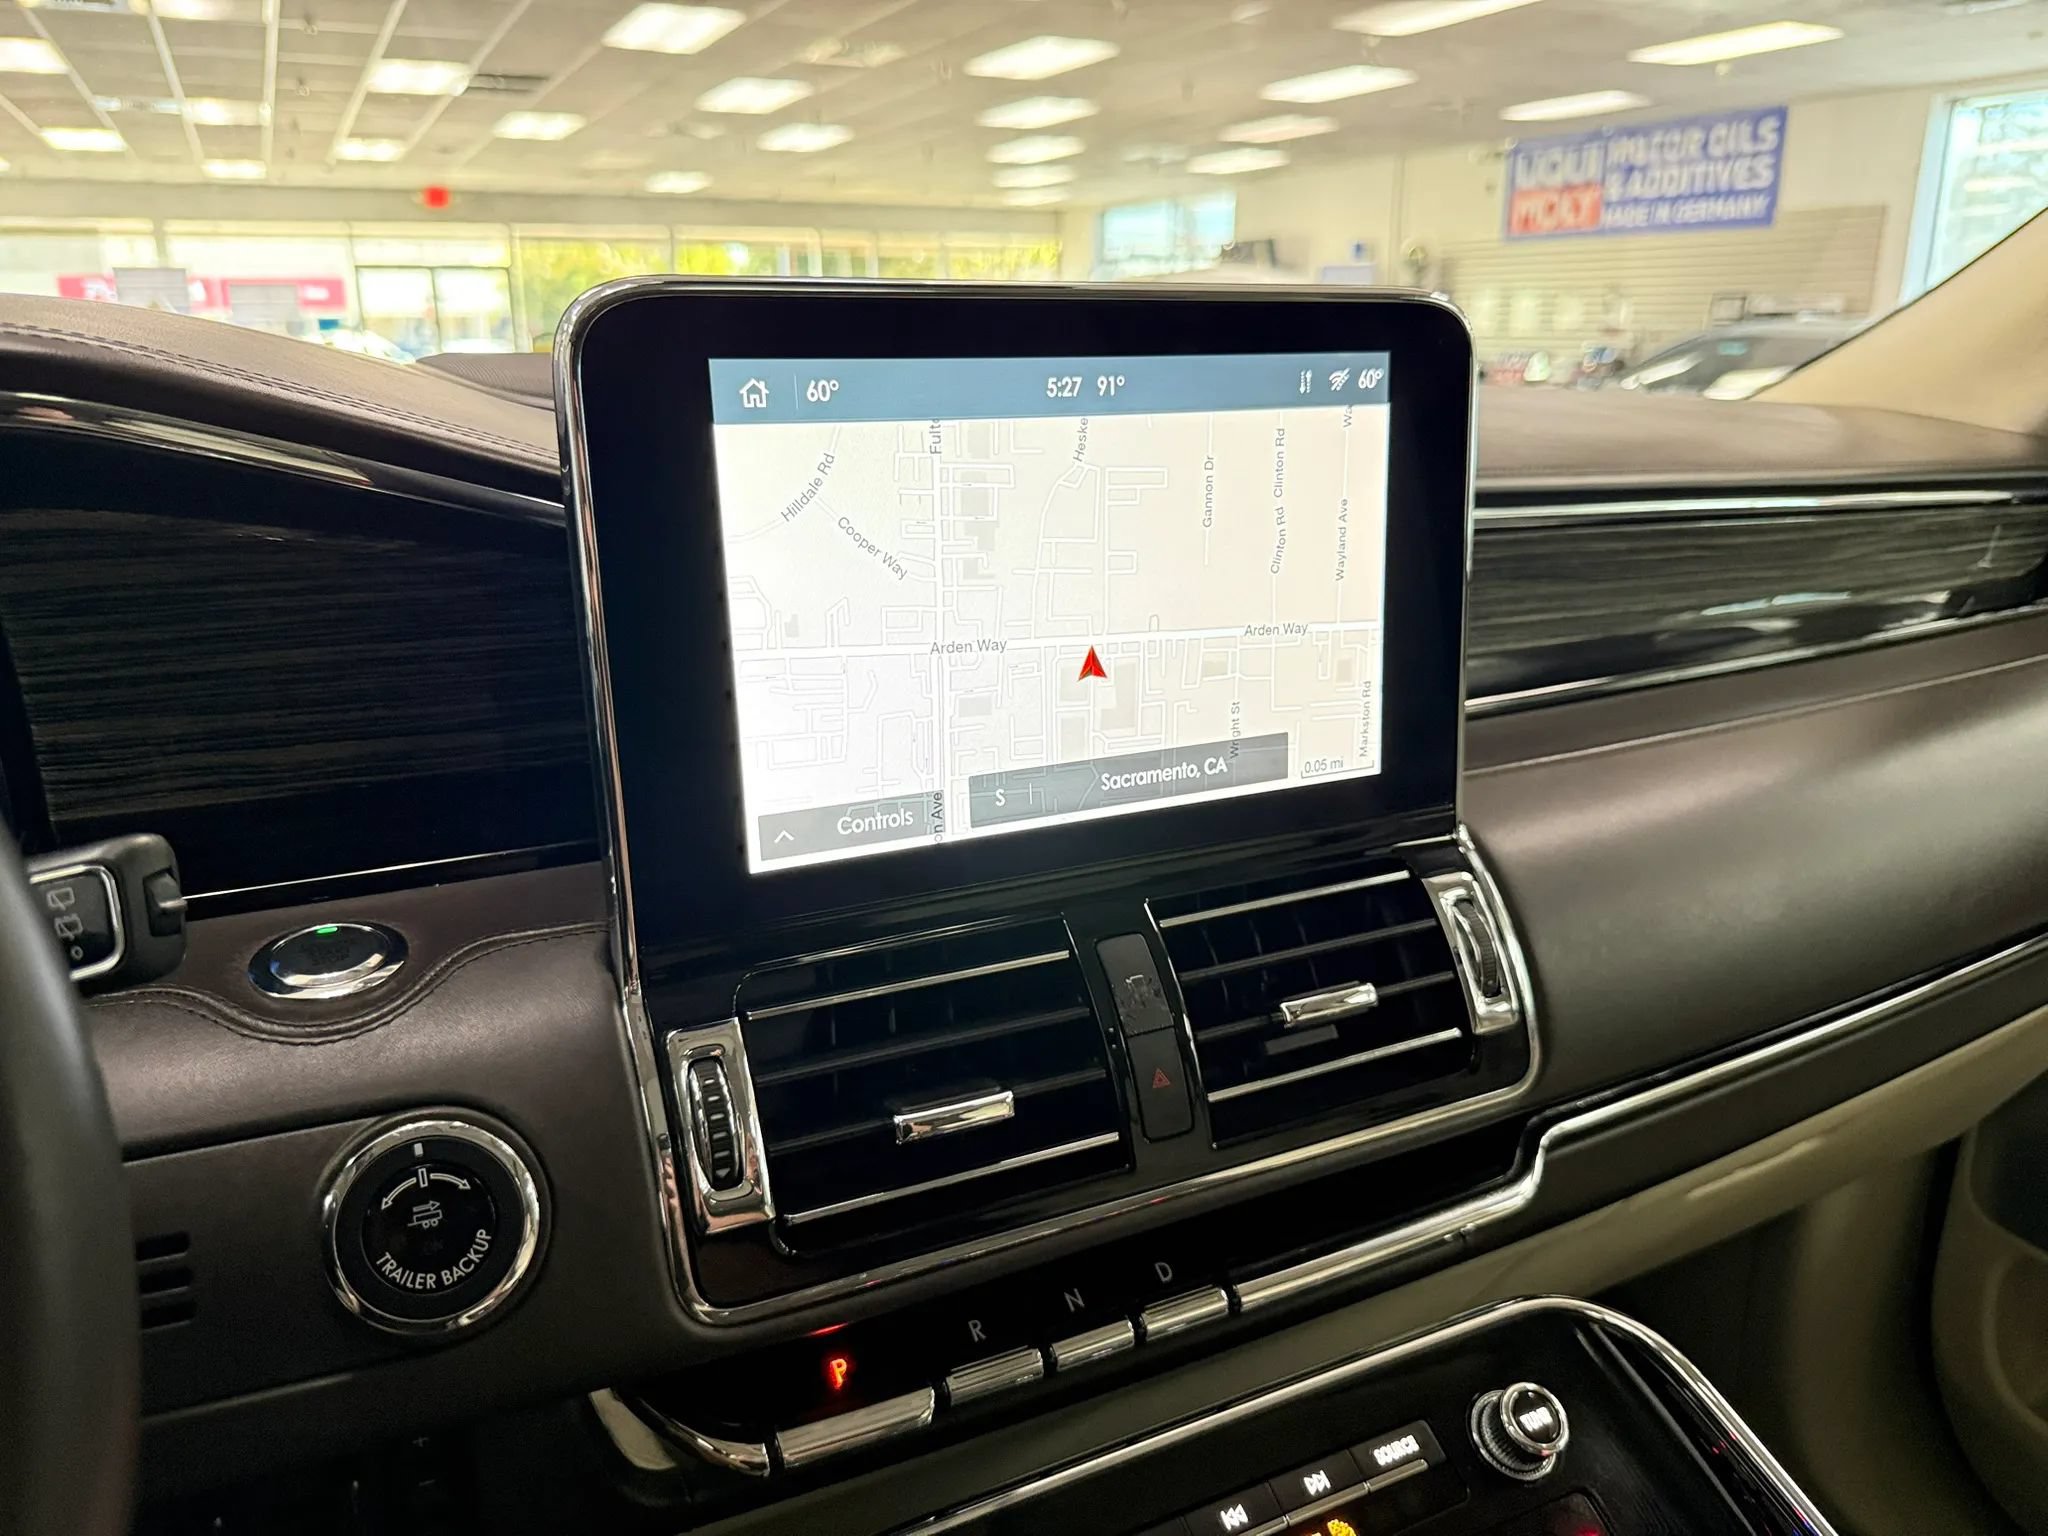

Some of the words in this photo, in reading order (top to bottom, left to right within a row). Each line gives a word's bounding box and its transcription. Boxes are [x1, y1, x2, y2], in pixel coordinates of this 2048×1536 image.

[1709, 115, 1781, 157] OILS
[1624, 155, 1776, 200] ADDITIVES
[806, 379, 840, 402] 60°
[1046, 376, 1083, 398] 5:27
[1096, 375, 1126, 397] 91°
[1357, 367, 1385, 390] 60°
[1275, 427, 1285, 447] Rd
[1204, 455, 1214, 471] Dr
[1273, 448, 1284, 498] Clinton
[781, 475, 823, 523] Hilldale
[816, 452, 836, 477] Rd
[1202, 476, 1214, 529] Gannon
[1276, 506, 1285, 526] Rd
[1338, 498, 1348, 523] Ave
[837, 516, 882, 558] Cooper
[882, 551, 909, 582] Way
[1270, 527, 1287, 575] Clinton
[1335, 525, 1347, 582] Wayland
[1244, 624, 1280, 637] Arden
[1281, 621, 1308, 636] Way
[930, 640, 974, 655] Arden
[976, 638, 1008, 654] Way
[1361, 680, 1371, 698] Rd
[1231, 700, 1240, 716] St
[1230, 717, 1241, 759] Wright
[1360, 700, 1370, 758] Markston
[1304, 759, 1328, 774] 0.05
[1329, 756, 1344, 770] mi
[995, 788, 1006, 807] S
[1100, 761, 1201, 791] Sacramento,
[1204, 755, 1228, 775] CA
[932, 792, 943, 820] Ave
[837, 808, 914, 836] Controls
[375, 1251, 437, 1290] TRAILER
[441, 1228, 492, 1286] BACKUP
[1154, 1261, 1173, 1284] D
[1064, 1287, 1086, 1313] N
[967, 1319, 987, 1343] R
[829, 1358, 847, 1389] P
